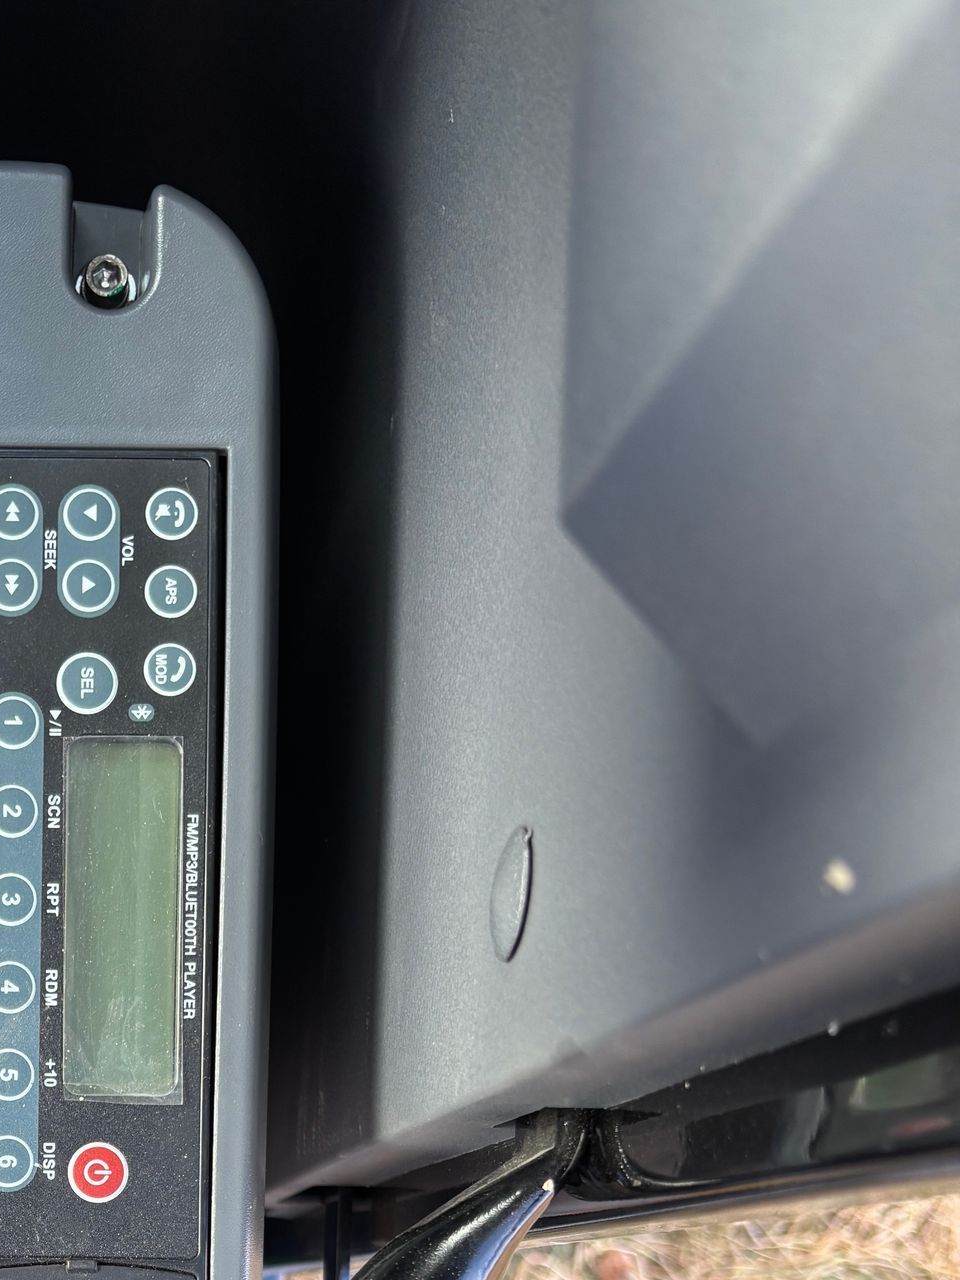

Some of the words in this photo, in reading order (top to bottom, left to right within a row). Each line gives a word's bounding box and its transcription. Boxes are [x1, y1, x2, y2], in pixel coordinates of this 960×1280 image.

[44, 529, 57, 570] SEEK
[121, 535, 135, 567] VOL
[165, 577, 178, 605] APS
[80, 667, 95, 699] SEL
[153, 653, 168, 688] MOD
[3, 715, 23, 726] 1
[2, 803, 22, 818] 2
[47, 794, 61, 829] SCN
[1, 892, 21, 906] 3
[46, 882, 60, 917] RPT
[0, 979, 20, 995] 4
[44, 969, 59, 1007] RDM
[184, 962, 197, 1019] PLAYER
[0, 1068, 19, 1082] 5
[43, 1058, 58, 1088] +10
[42, 1142, 56, 1181] DISP
